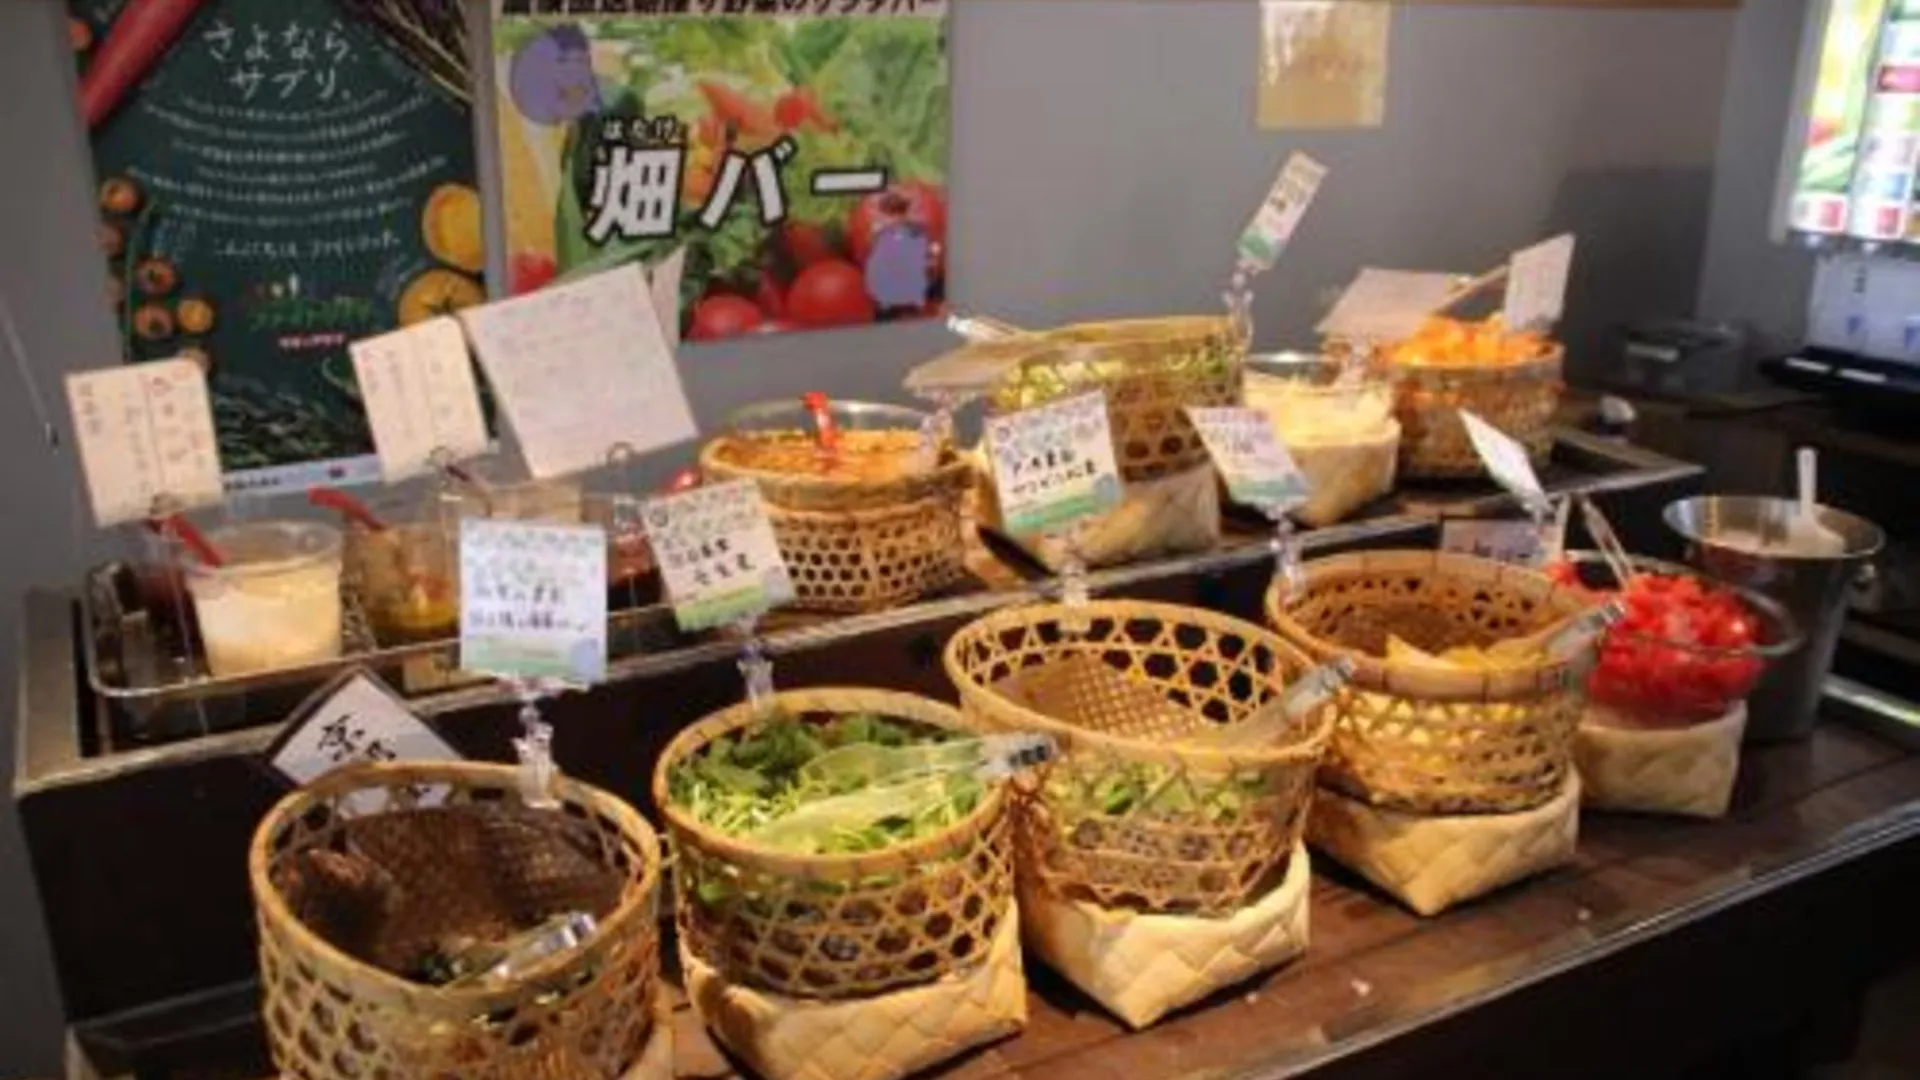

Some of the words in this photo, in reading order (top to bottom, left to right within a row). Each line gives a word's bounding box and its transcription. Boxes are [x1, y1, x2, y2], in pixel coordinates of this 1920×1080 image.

[203, 20, 359, 61] さよなら、
[585, 136, 887, 246] 畑バー
